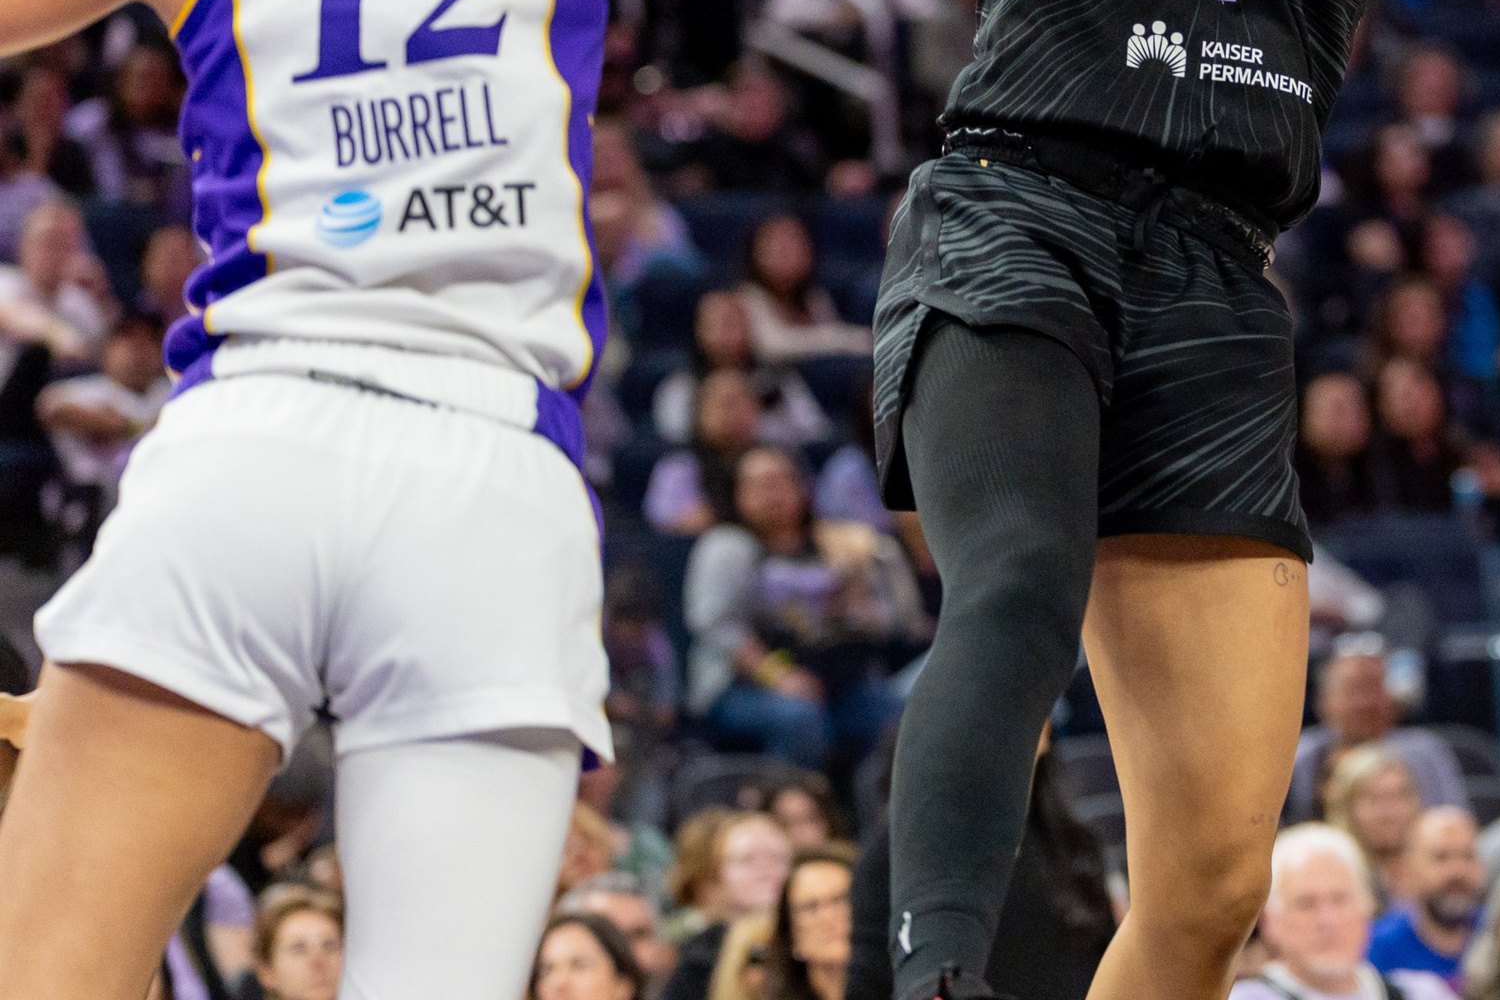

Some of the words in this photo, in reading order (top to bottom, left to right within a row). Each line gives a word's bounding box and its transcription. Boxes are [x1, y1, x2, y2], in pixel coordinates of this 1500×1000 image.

[1202, 41, 1263, 65] KAISER
[1200, 63, 1313, 104] PERMANENTE
[332, 82, 507, 167] BURRELL
[399, 183, 535, 231] AT&T
